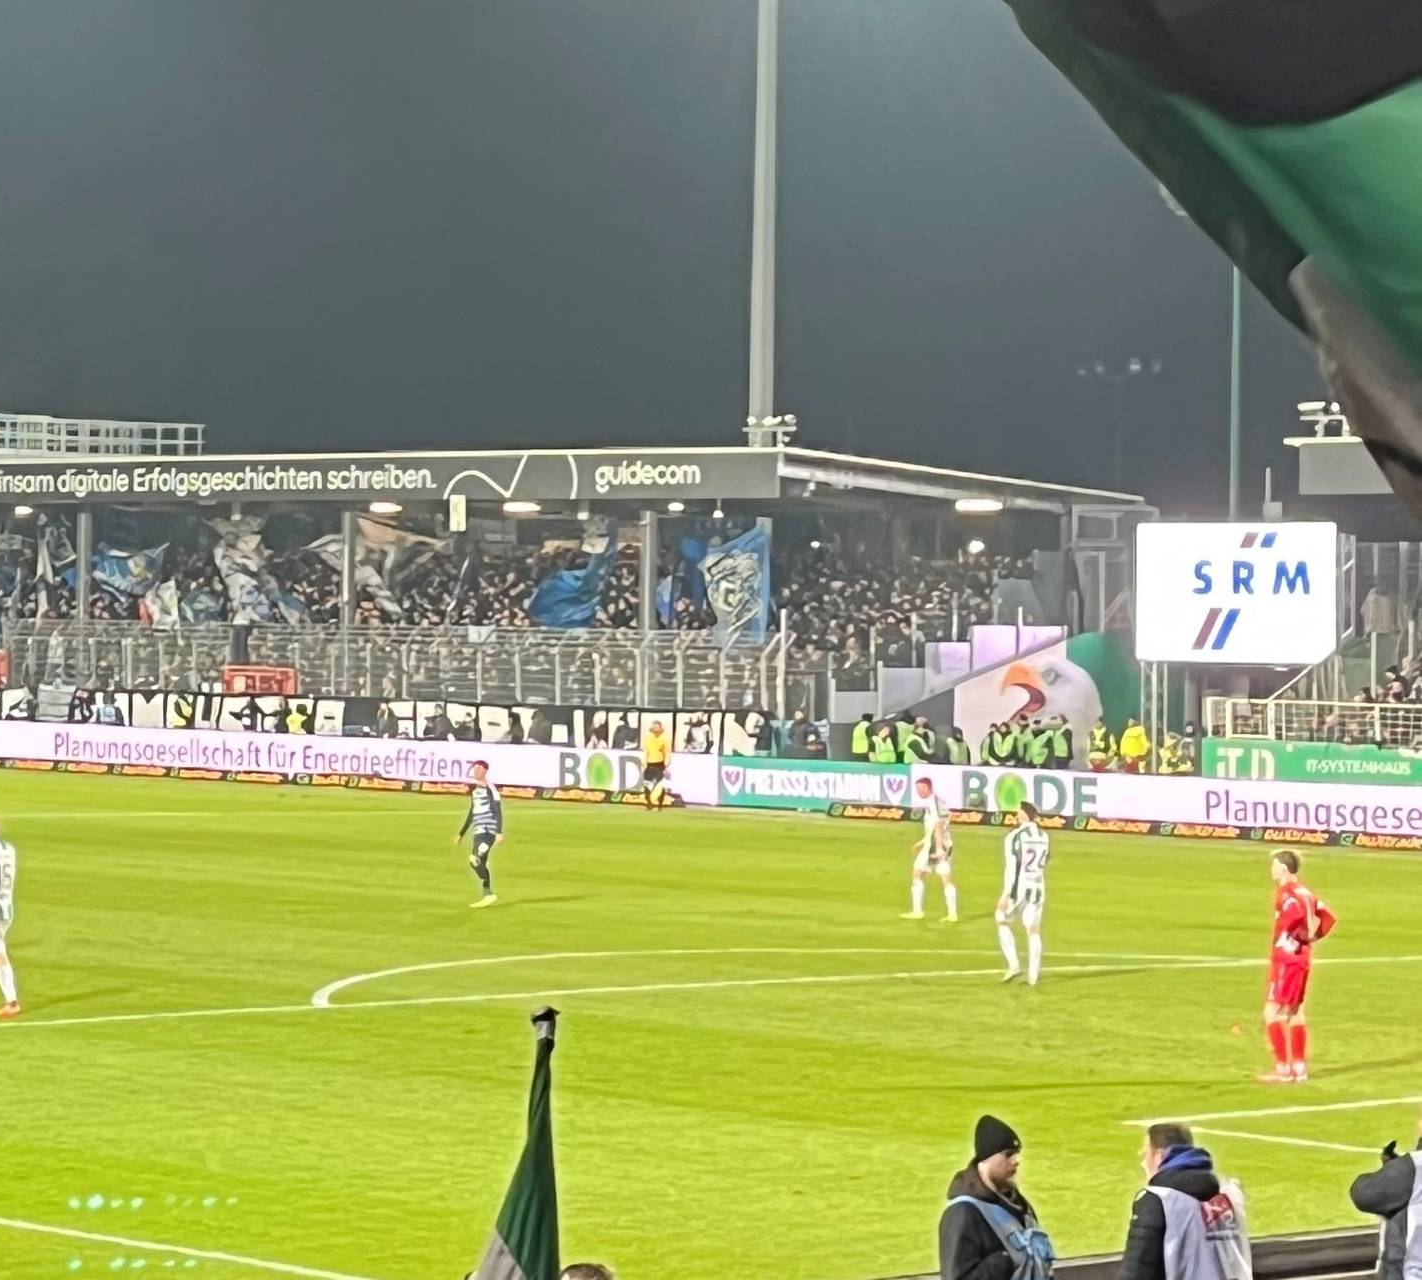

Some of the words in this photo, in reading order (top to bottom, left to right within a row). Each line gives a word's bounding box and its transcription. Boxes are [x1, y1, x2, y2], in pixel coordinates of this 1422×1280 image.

[57, 468, 129, 498] digitale
[133, 464, 323, 498] Erfolgsgeschichten
[327, 463, 438, 490] schreiben.
[594, 459, 702, 494] guidecom
[54, 731, 261, 769] Planungsgesellschaft
[267, 741, 296, 770] für
[559, 751, 666, 791] BOD
[962, 769, 1098, 819] BODE
